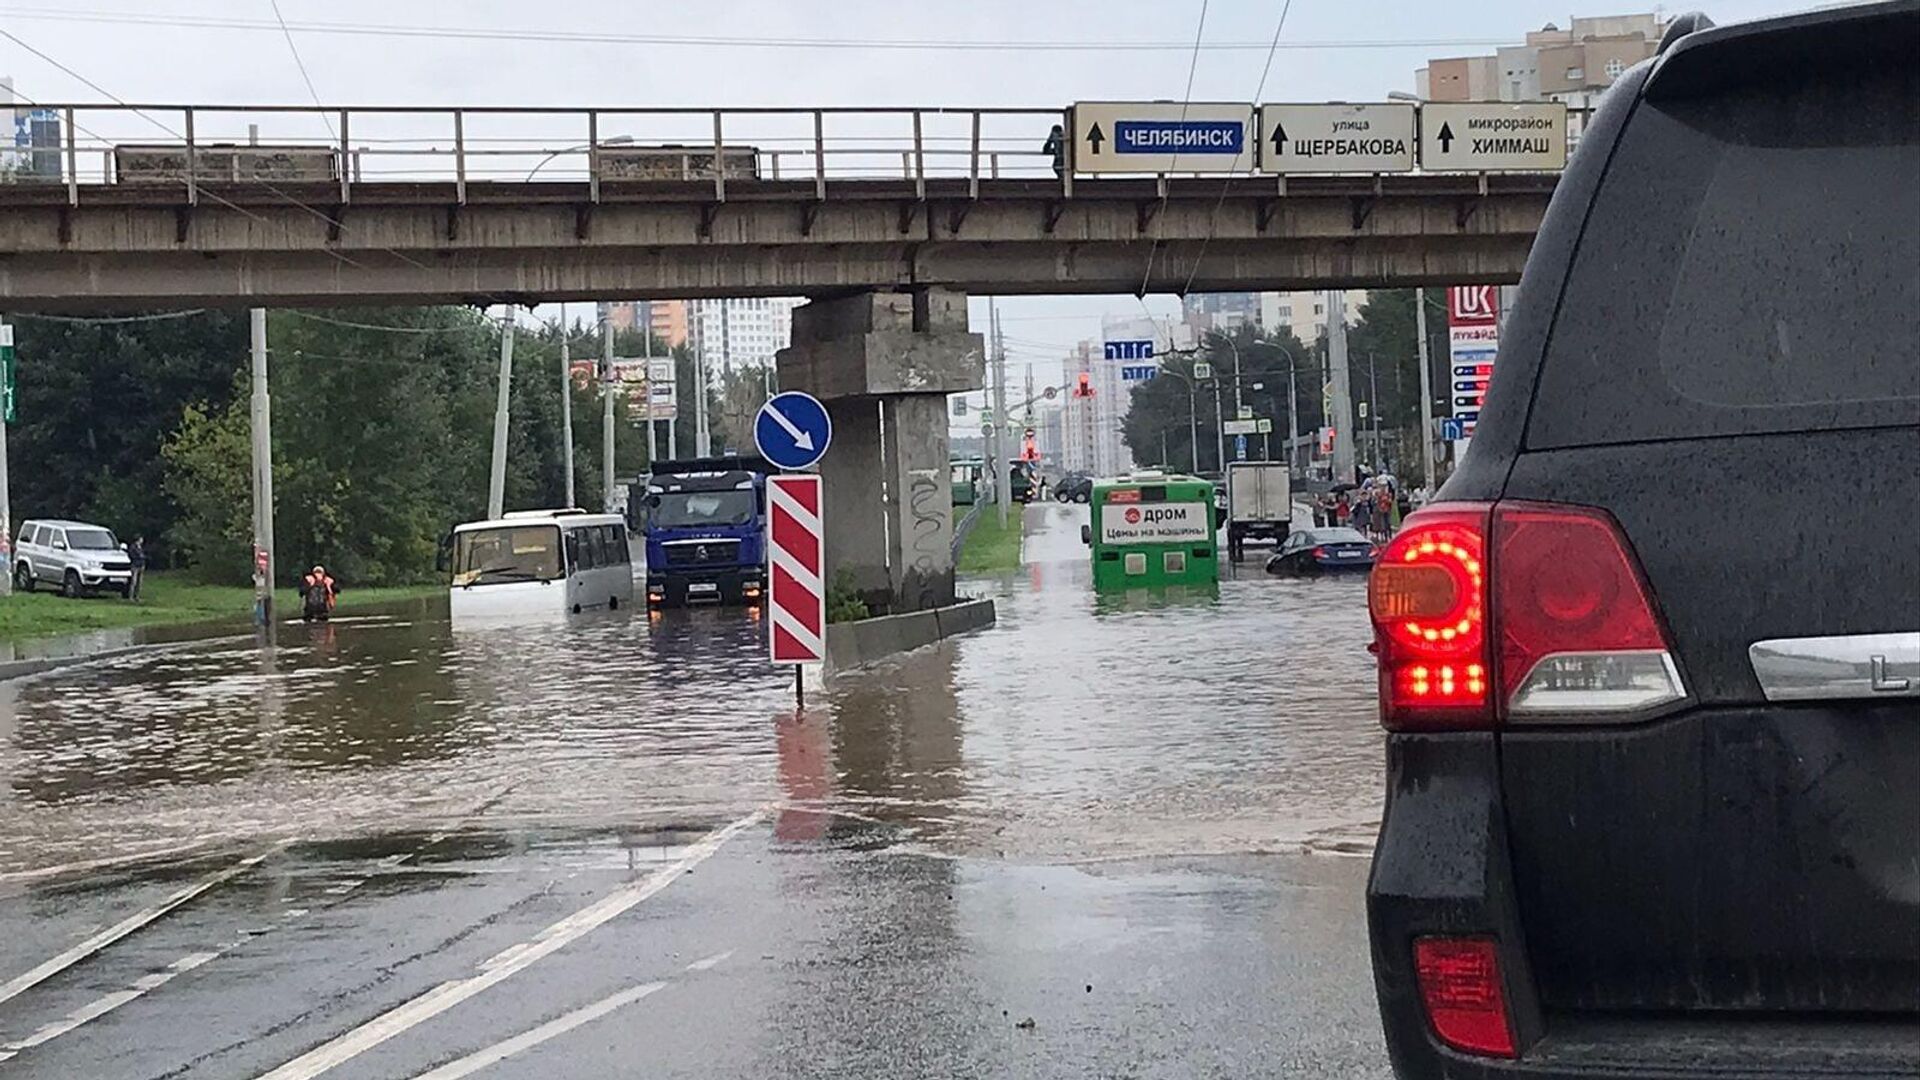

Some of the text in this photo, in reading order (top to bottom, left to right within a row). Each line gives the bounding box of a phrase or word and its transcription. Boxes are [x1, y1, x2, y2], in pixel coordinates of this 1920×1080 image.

[1332, 120, 1370, 133] улица
[1468, 116, 1553, 132] микрорайон
[1124, 129, 1234, 146] ЧЕЛЯБИНСК
[1294, 139, 1406, 158] ЩЕРБАКОВА
[1471, 138, 1549, 154] ХИММАШ
[1143, 508, 1187, 524] дром
[1106, 529, 1138, 539] Цены
[1157, 528, 1205, 536] машины
